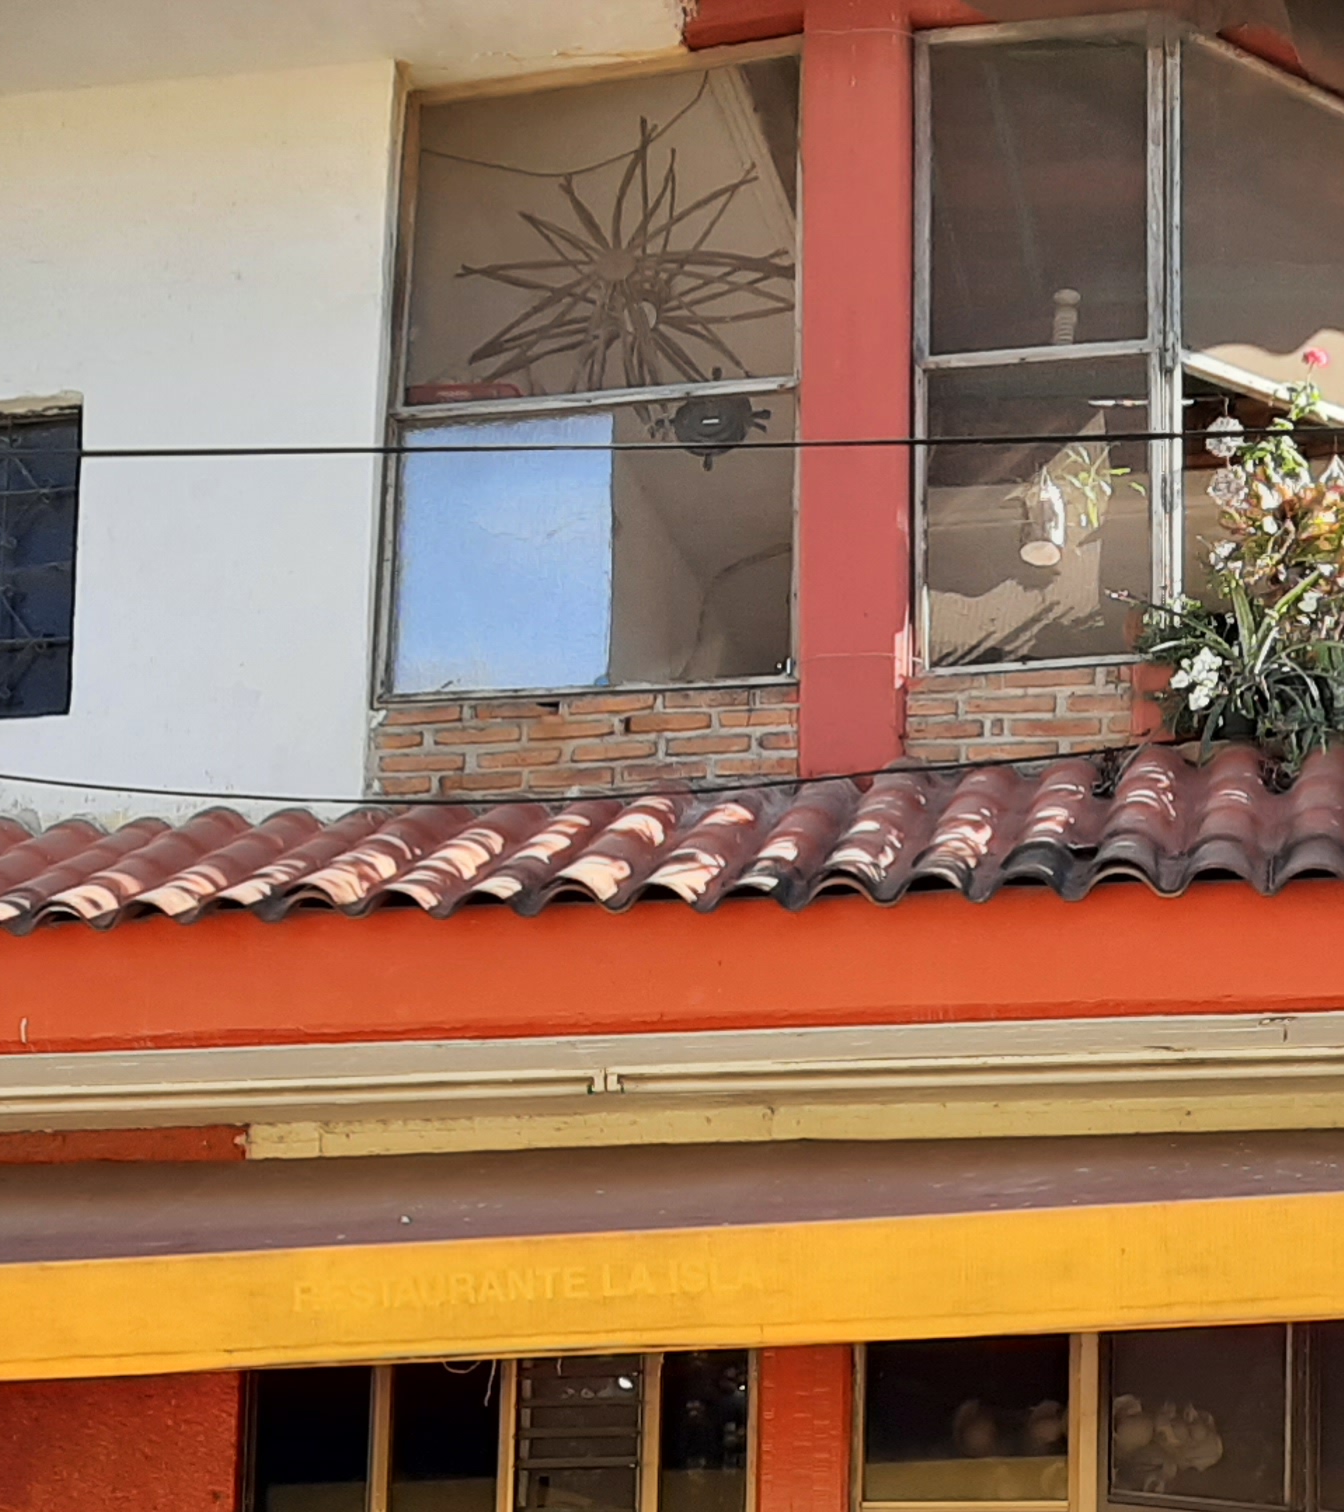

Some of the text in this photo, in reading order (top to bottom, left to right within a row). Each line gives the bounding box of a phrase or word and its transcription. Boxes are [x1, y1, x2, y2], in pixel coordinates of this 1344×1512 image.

[292, 1256, 764, 1313] RESTAURANTE LA ISLA
